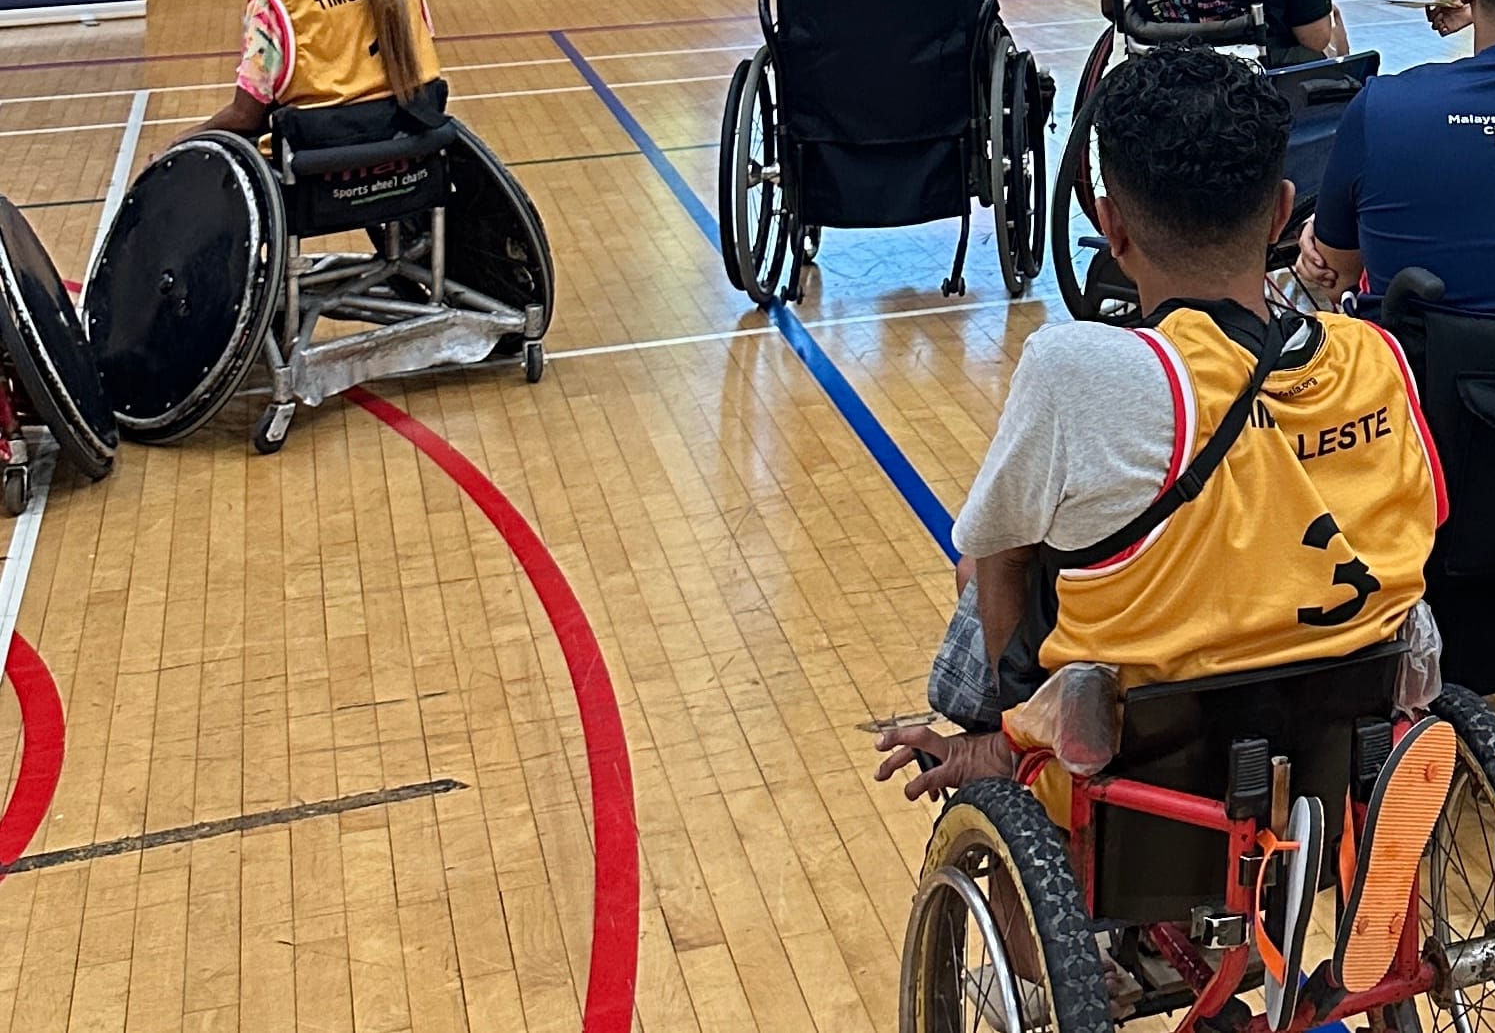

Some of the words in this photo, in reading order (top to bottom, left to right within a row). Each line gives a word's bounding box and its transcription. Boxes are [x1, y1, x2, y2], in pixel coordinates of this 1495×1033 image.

[333, 185, 369, 199] sports
[1297, 406, 1392, 461] LESTE
[1296, 511, 1382, 628] 3
